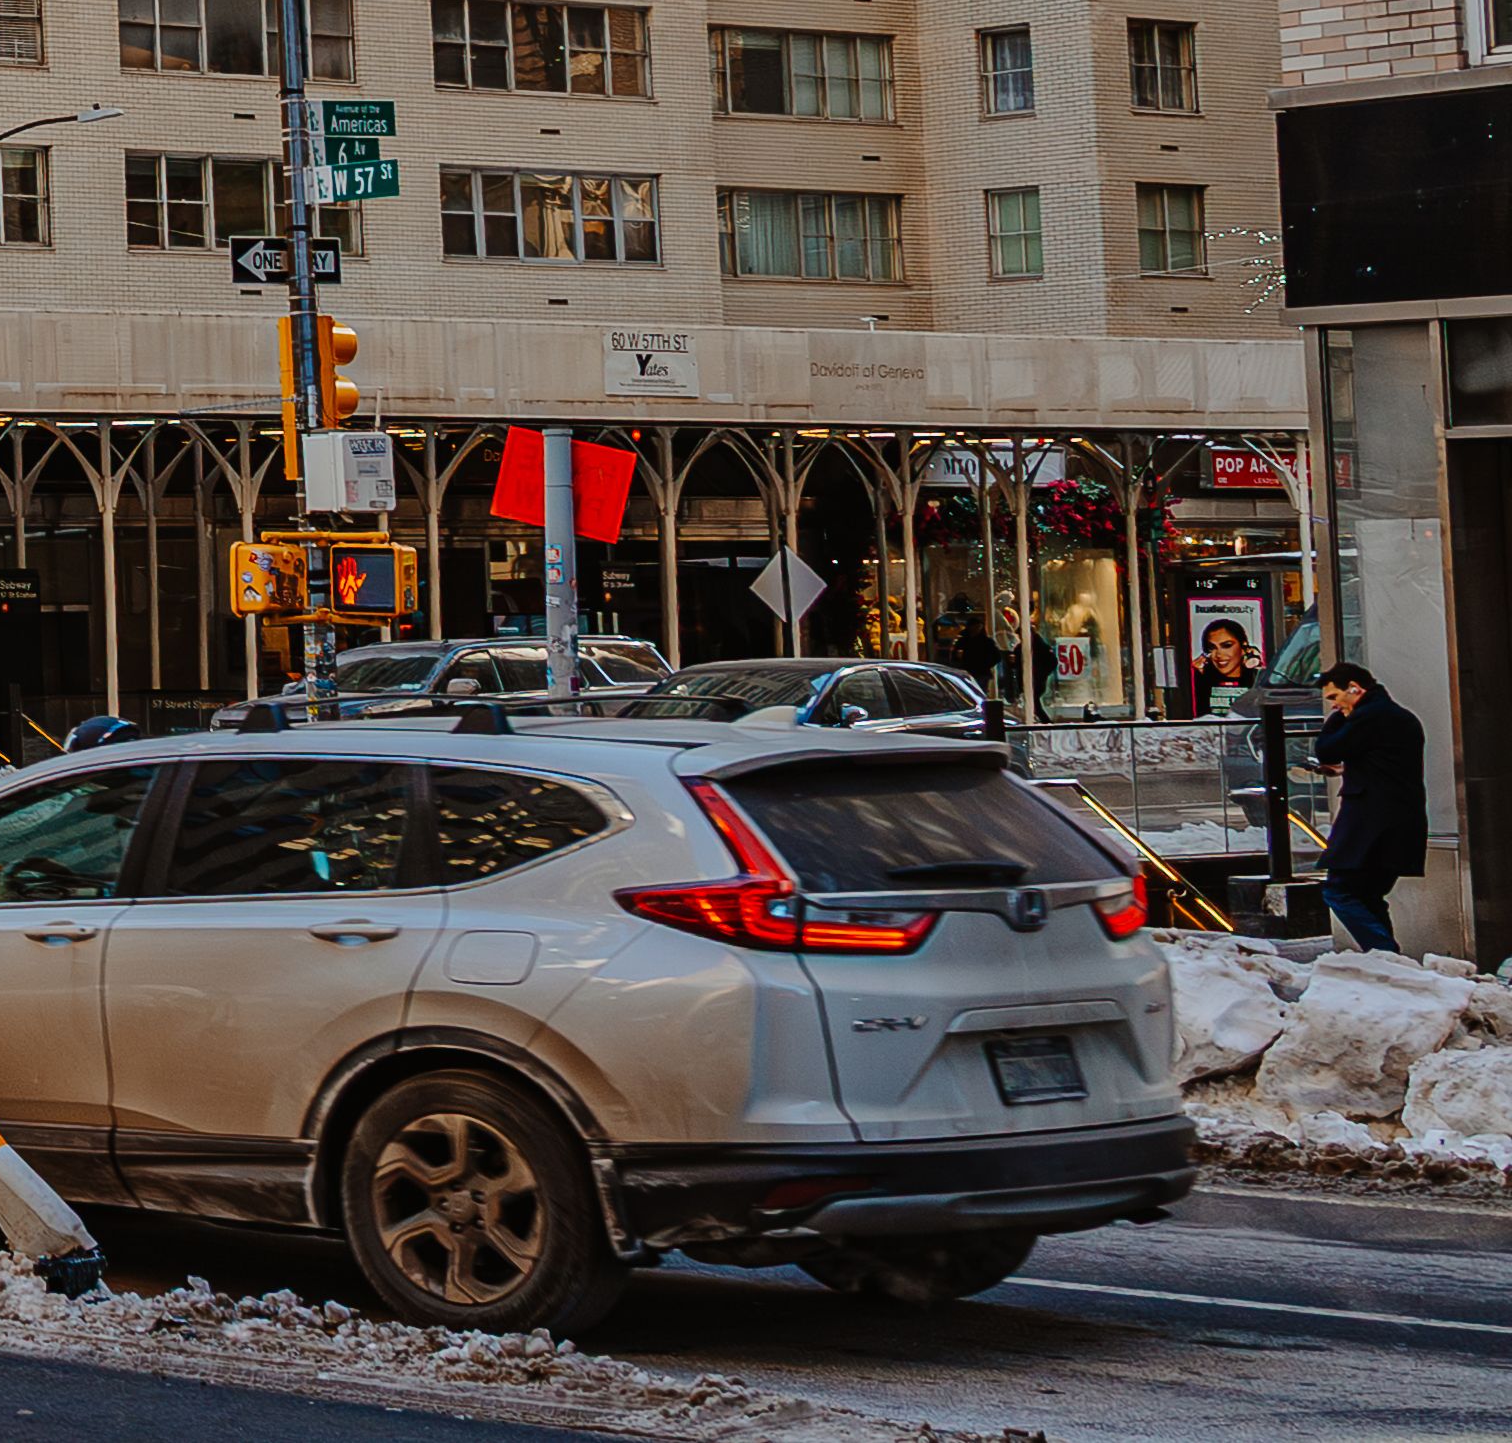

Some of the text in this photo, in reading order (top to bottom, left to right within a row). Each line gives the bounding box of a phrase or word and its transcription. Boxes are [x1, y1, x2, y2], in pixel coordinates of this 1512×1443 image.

[330, 115, 387, 133] Americas
[338, 141, 366, 165] 6 Av
[334, 163, 392, 196] W 57 St
[253, 252, 281, 270] ONE
[611, 332, 688, 351] 60 W 57TH ST
[636, 354, 669, 376] Yates
[810, 362, 924, 379] Davidoff of Geneva
[1215, 457, 1244, 473] POP
[0, 580, 31, 590] Subway
[1058, 644, 1084, 675] 50
